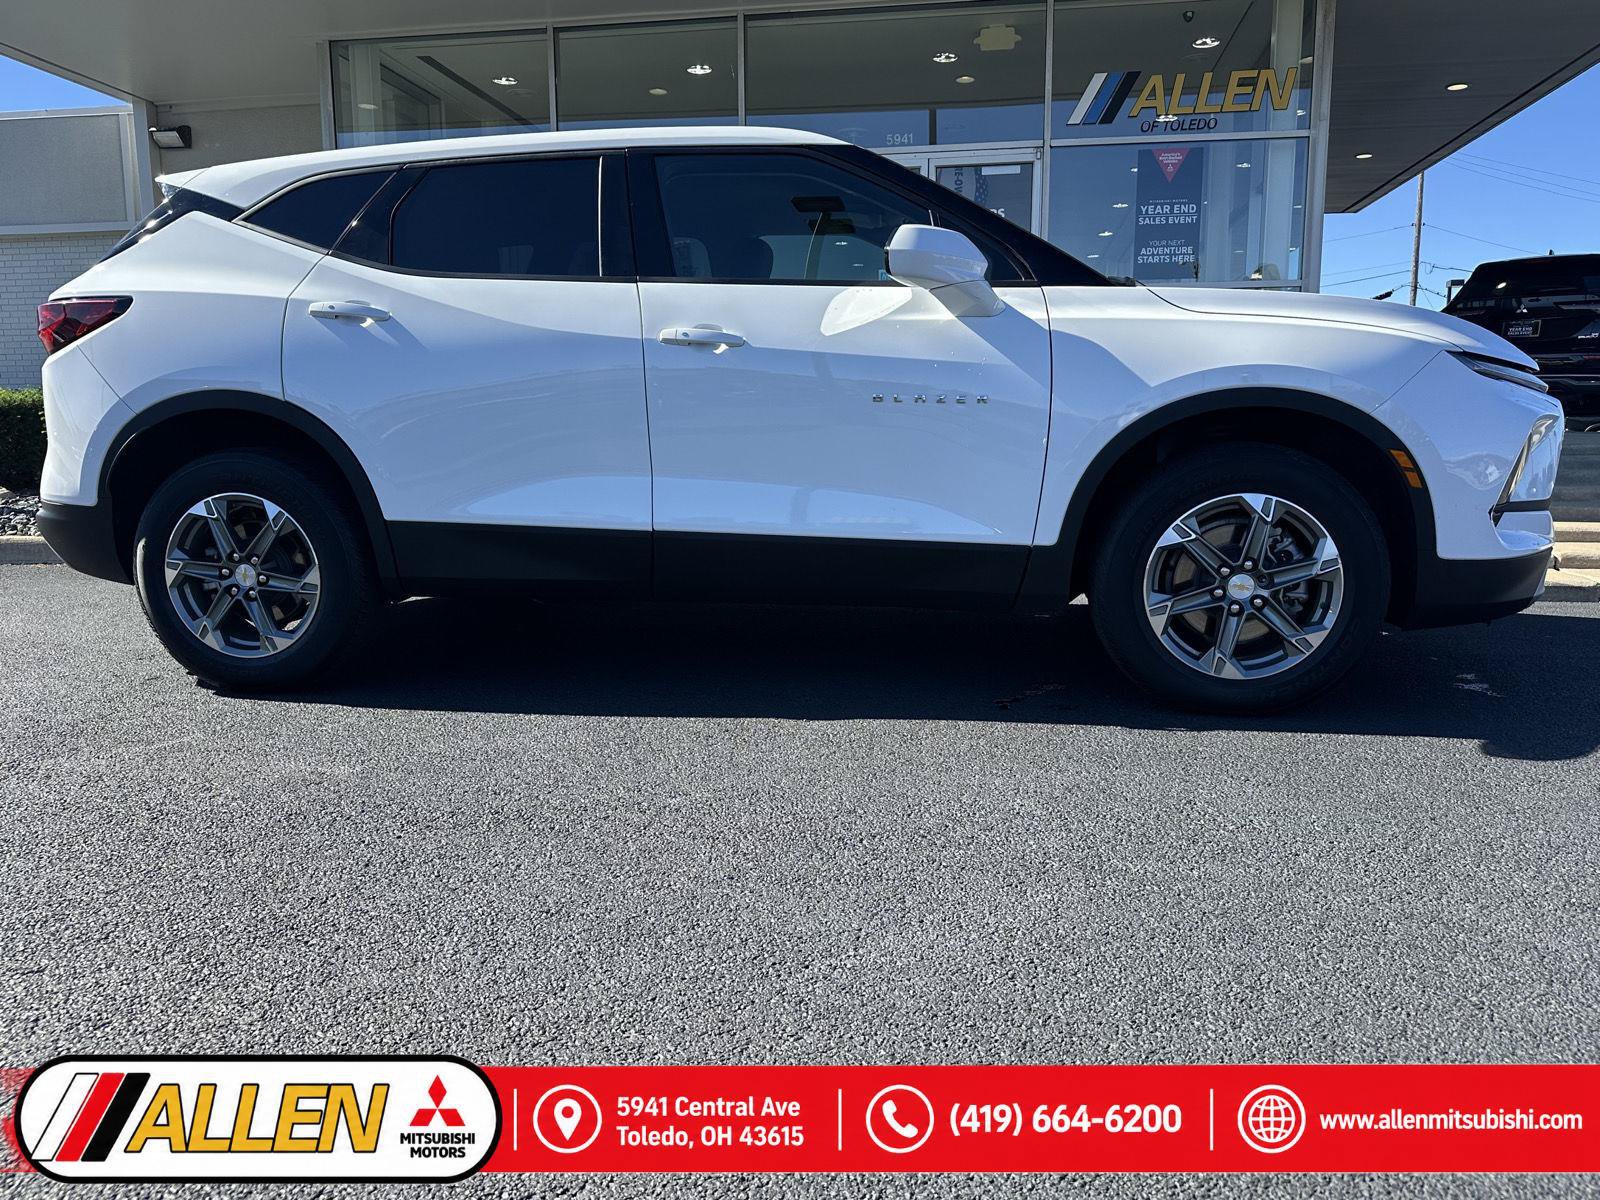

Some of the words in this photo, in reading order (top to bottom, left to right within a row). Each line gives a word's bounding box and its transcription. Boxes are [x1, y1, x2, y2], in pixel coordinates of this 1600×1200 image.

[1129, 67, 1298, 117] ALLEN
[1140, 121, 1159, 133] OF
[1163, 117, 1218, 132] TOLEDO
[886, 133, 914, 145] 5941
[1140, 204, 1171, 215] YEAR
[1173, 204, 1197, 213] END
[1138, 217, 1166, 225] SALES
[1168, 215, 1198, 224] EVENT
[1140, 246, 1193, 255] ADVENTURE
[1137, 255, 1170, 264] STARTS
[1171, 254, 1195, 263] HERE
[872, 394, 989, 404] BLAZER
